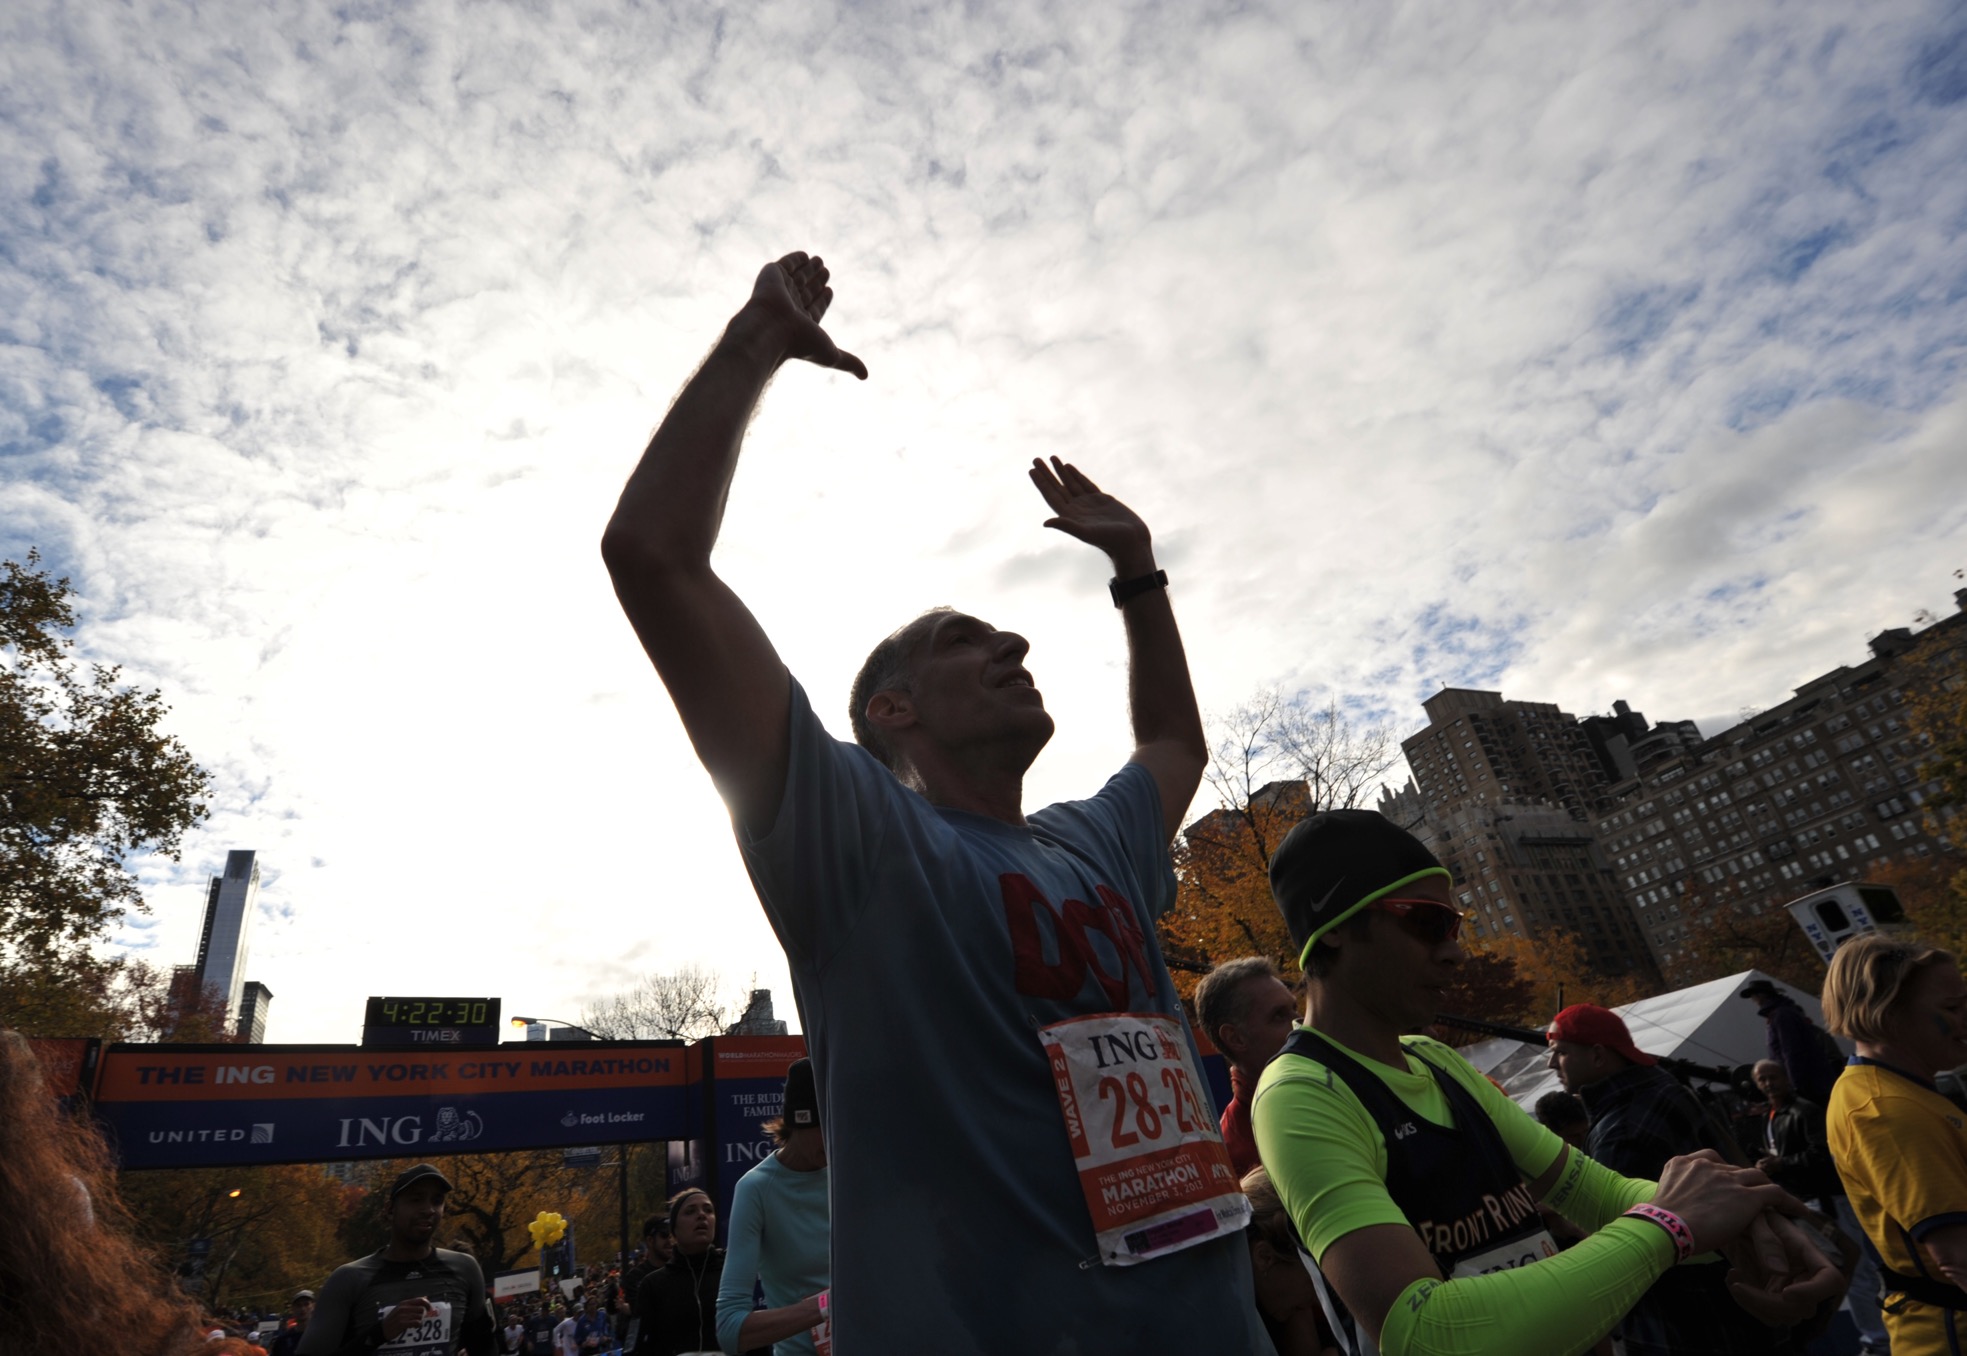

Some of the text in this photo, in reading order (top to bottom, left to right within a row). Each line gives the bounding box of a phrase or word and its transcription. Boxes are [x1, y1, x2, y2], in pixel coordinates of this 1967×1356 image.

[410, 1030, 461, 1041] TIMEX
[1088, 1031, 1158, 1069] ING
[136, 1057, 670, 1085] THE ING NEW YORK CITY MARATHON
[731, 1093, 755, 1106] THE
[743, 1105, 784, 1118] FAMILY
[1053, 1057, 1081, 1139] WAVE 2
[336, 1115, 423, 1147] ING
[580, 1111, 645, 1125] Foot Locker
[148, 1129, 245, 1144] UNITED
[726, 1140, 775, 1163] ING
[1098, 1153, 1191, 1186] THE ING NEW YORK CITY
[1101, 1162, 1200, 1205] MARATHON
[1107, 1190, 1170, 1217] NOVEMBER
[1173, 1186, 1183, 1197] 3,
[1184, 1180, 1204, 1194] 2013
[1418, 1208, 1489, 1254] FRONT
